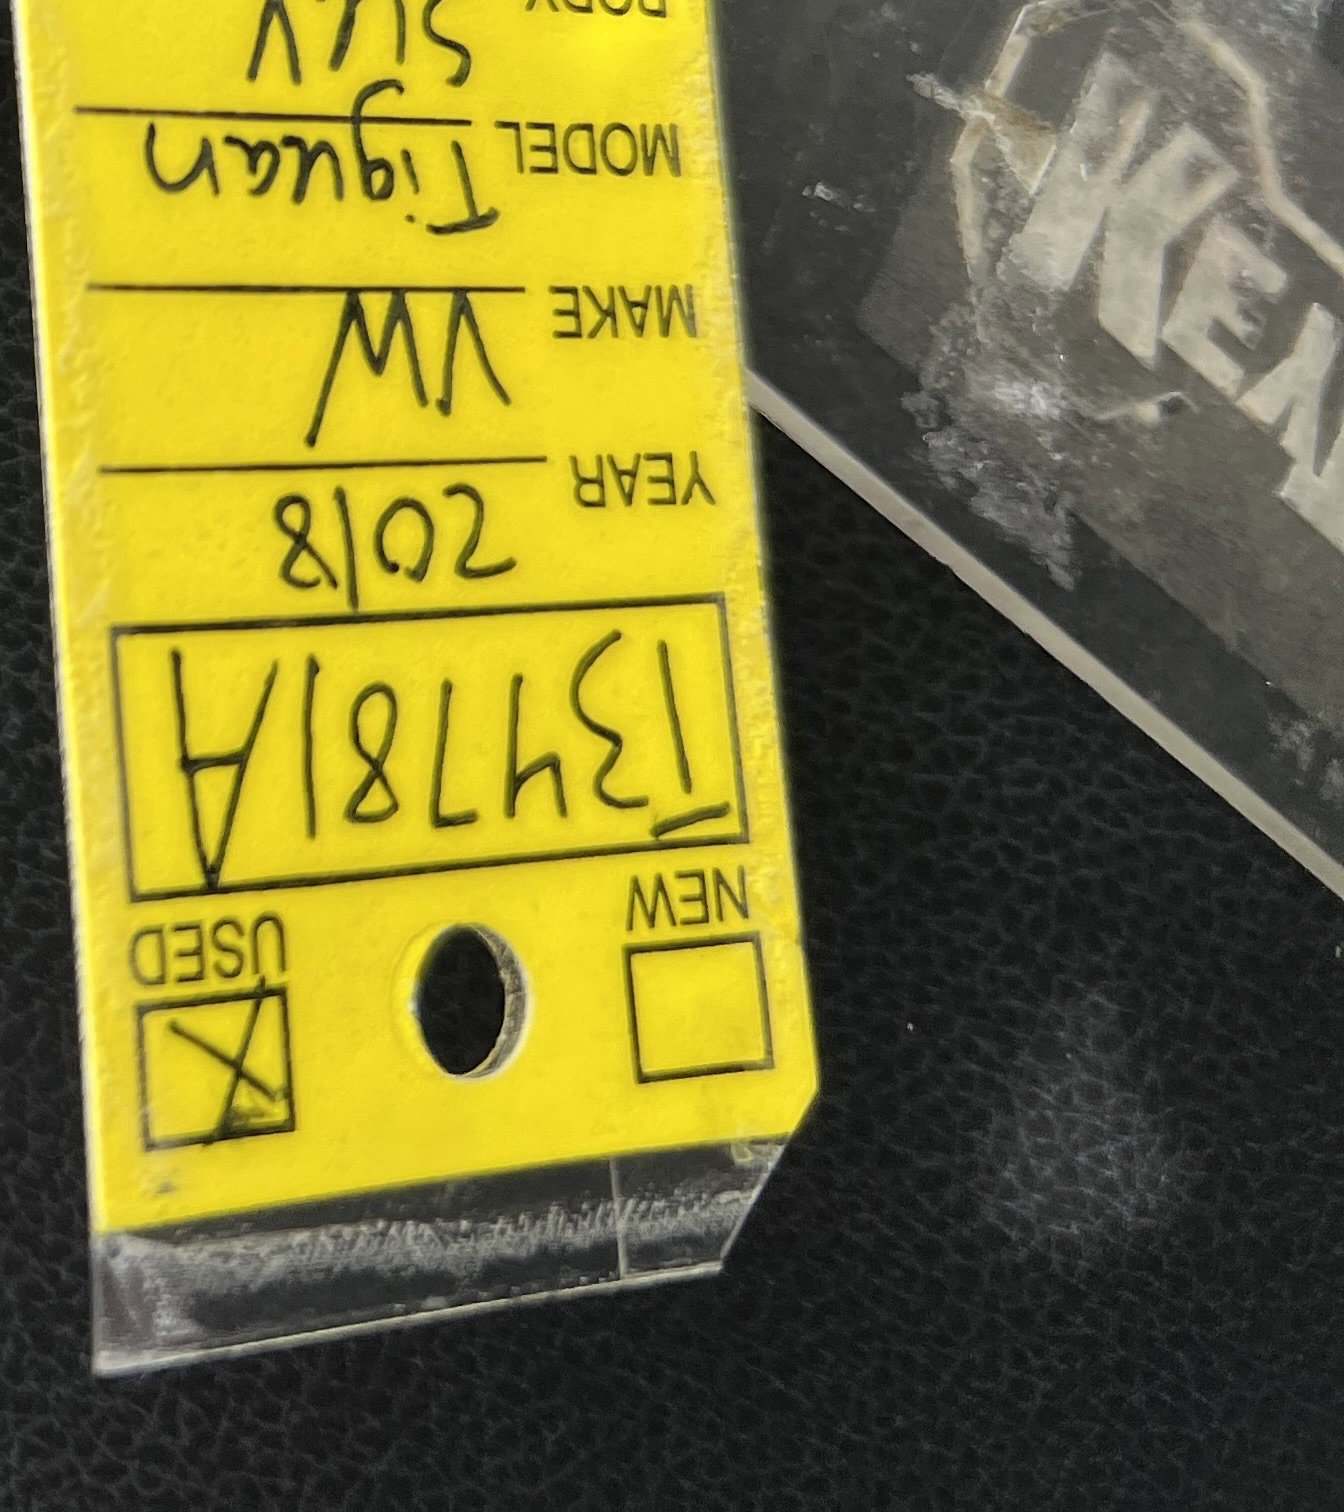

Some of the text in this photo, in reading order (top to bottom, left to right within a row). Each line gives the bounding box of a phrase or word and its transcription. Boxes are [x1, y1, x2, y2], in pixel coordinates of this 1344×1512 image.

[145, 79, 500, 235] Tiguan
[494, 120, 681, 177] MODEL
[551, 286, 697, 338] MAKE
[306, 289, 511, 447] VW
[569, 452, 716, 508] YEAR
[274, 483, 517, 612] 2018
[627, 866, 751, 931] NEW
[128, 914, 288, 986] USED
